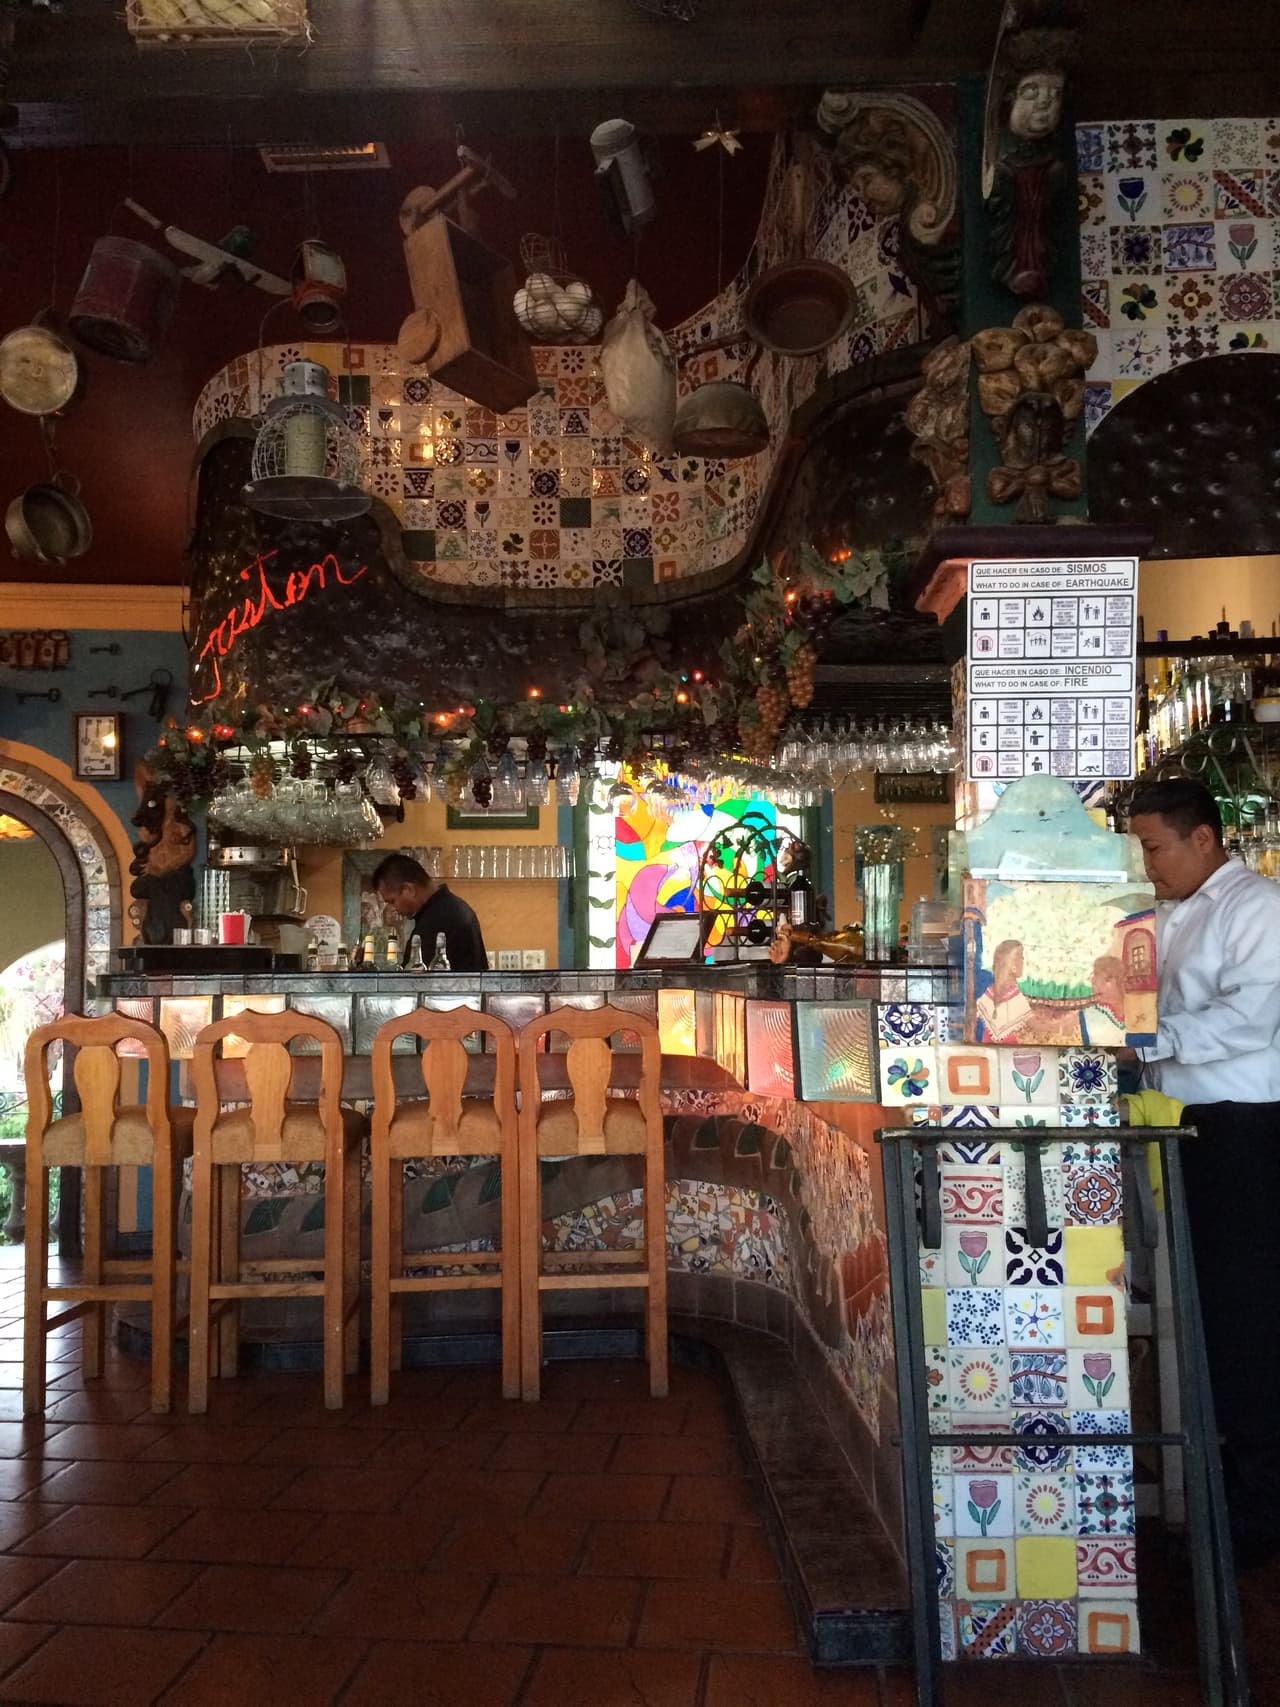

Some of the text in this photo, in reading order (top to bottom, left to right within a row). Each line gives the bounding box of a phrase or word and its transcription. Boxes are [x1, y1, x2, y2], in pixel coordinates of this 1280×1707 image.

[1066, 563, 1107, 573] SISMOS
[1066, 578, 1129, 588] EARTHQUAKE
[1064, 665, 1112, 675] INCENDIO
[1064, 677, 1089, 687] FIRE
